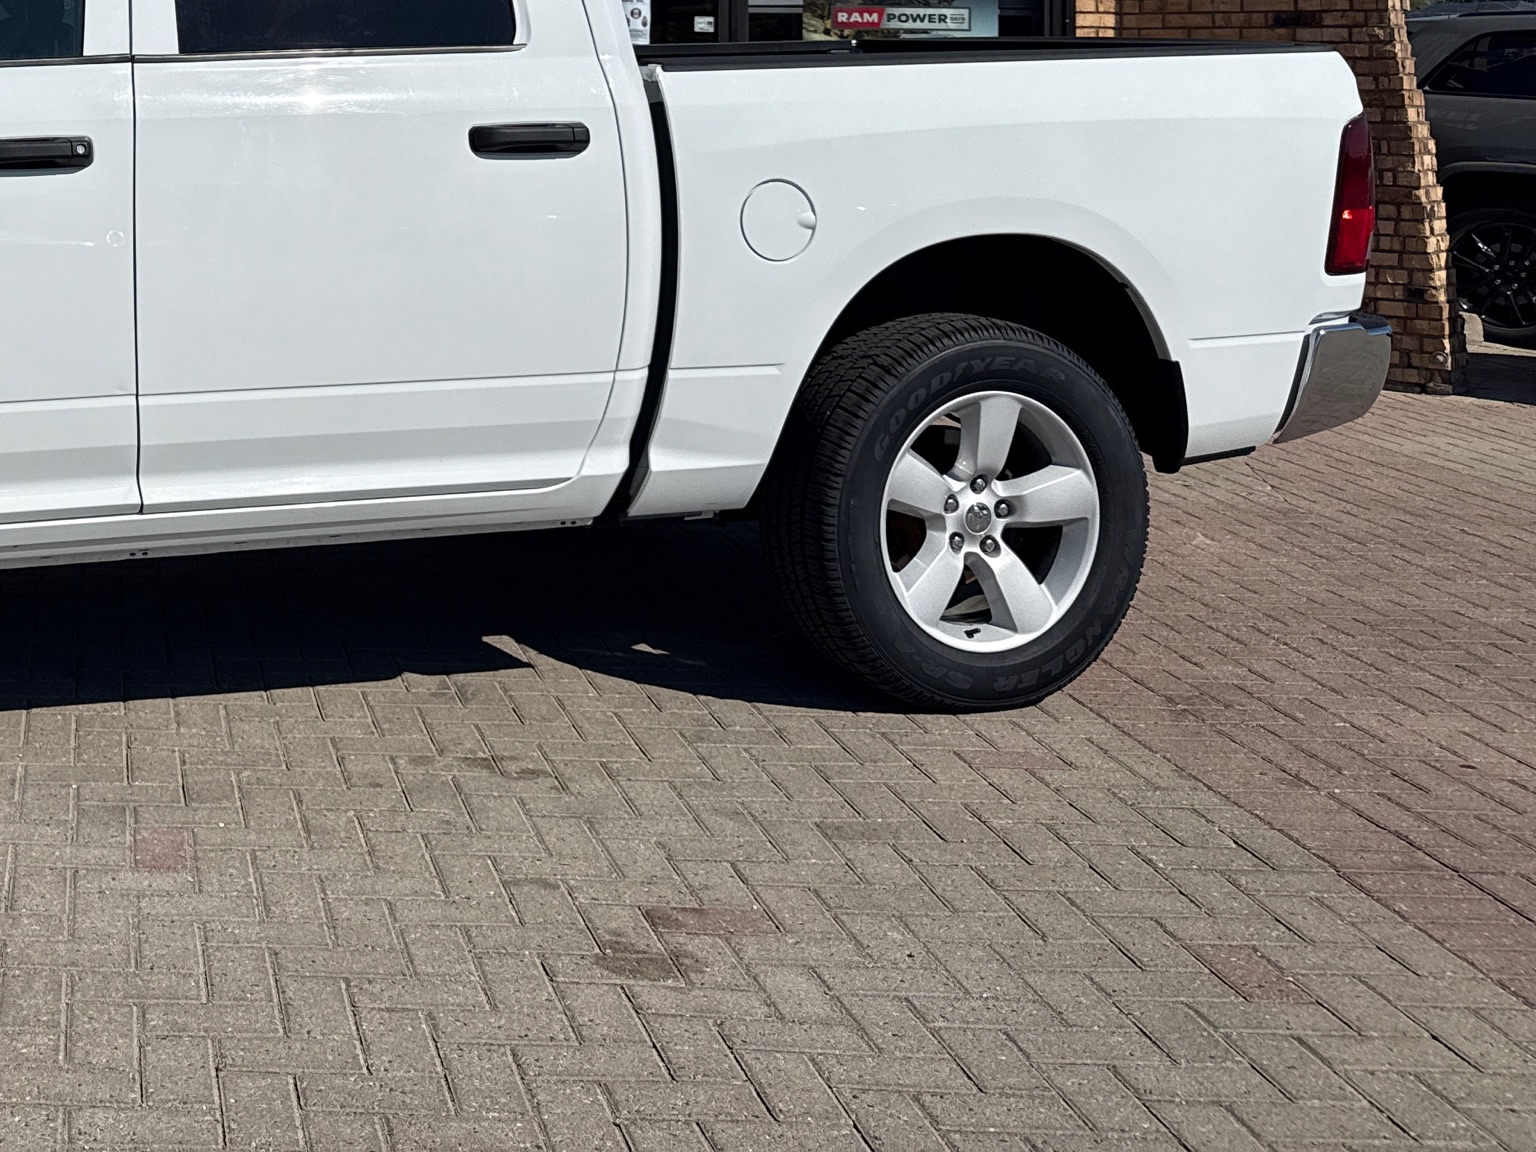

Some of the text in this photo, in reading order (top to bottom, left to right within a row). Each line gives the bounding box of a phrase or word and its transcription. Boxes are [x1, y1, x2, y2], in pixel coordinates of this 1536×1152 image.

[837, 11, 879, 24] RAM
[886, 12, 948, 24] POWER
[874, 355, 1067, 463] GOODYEAR
